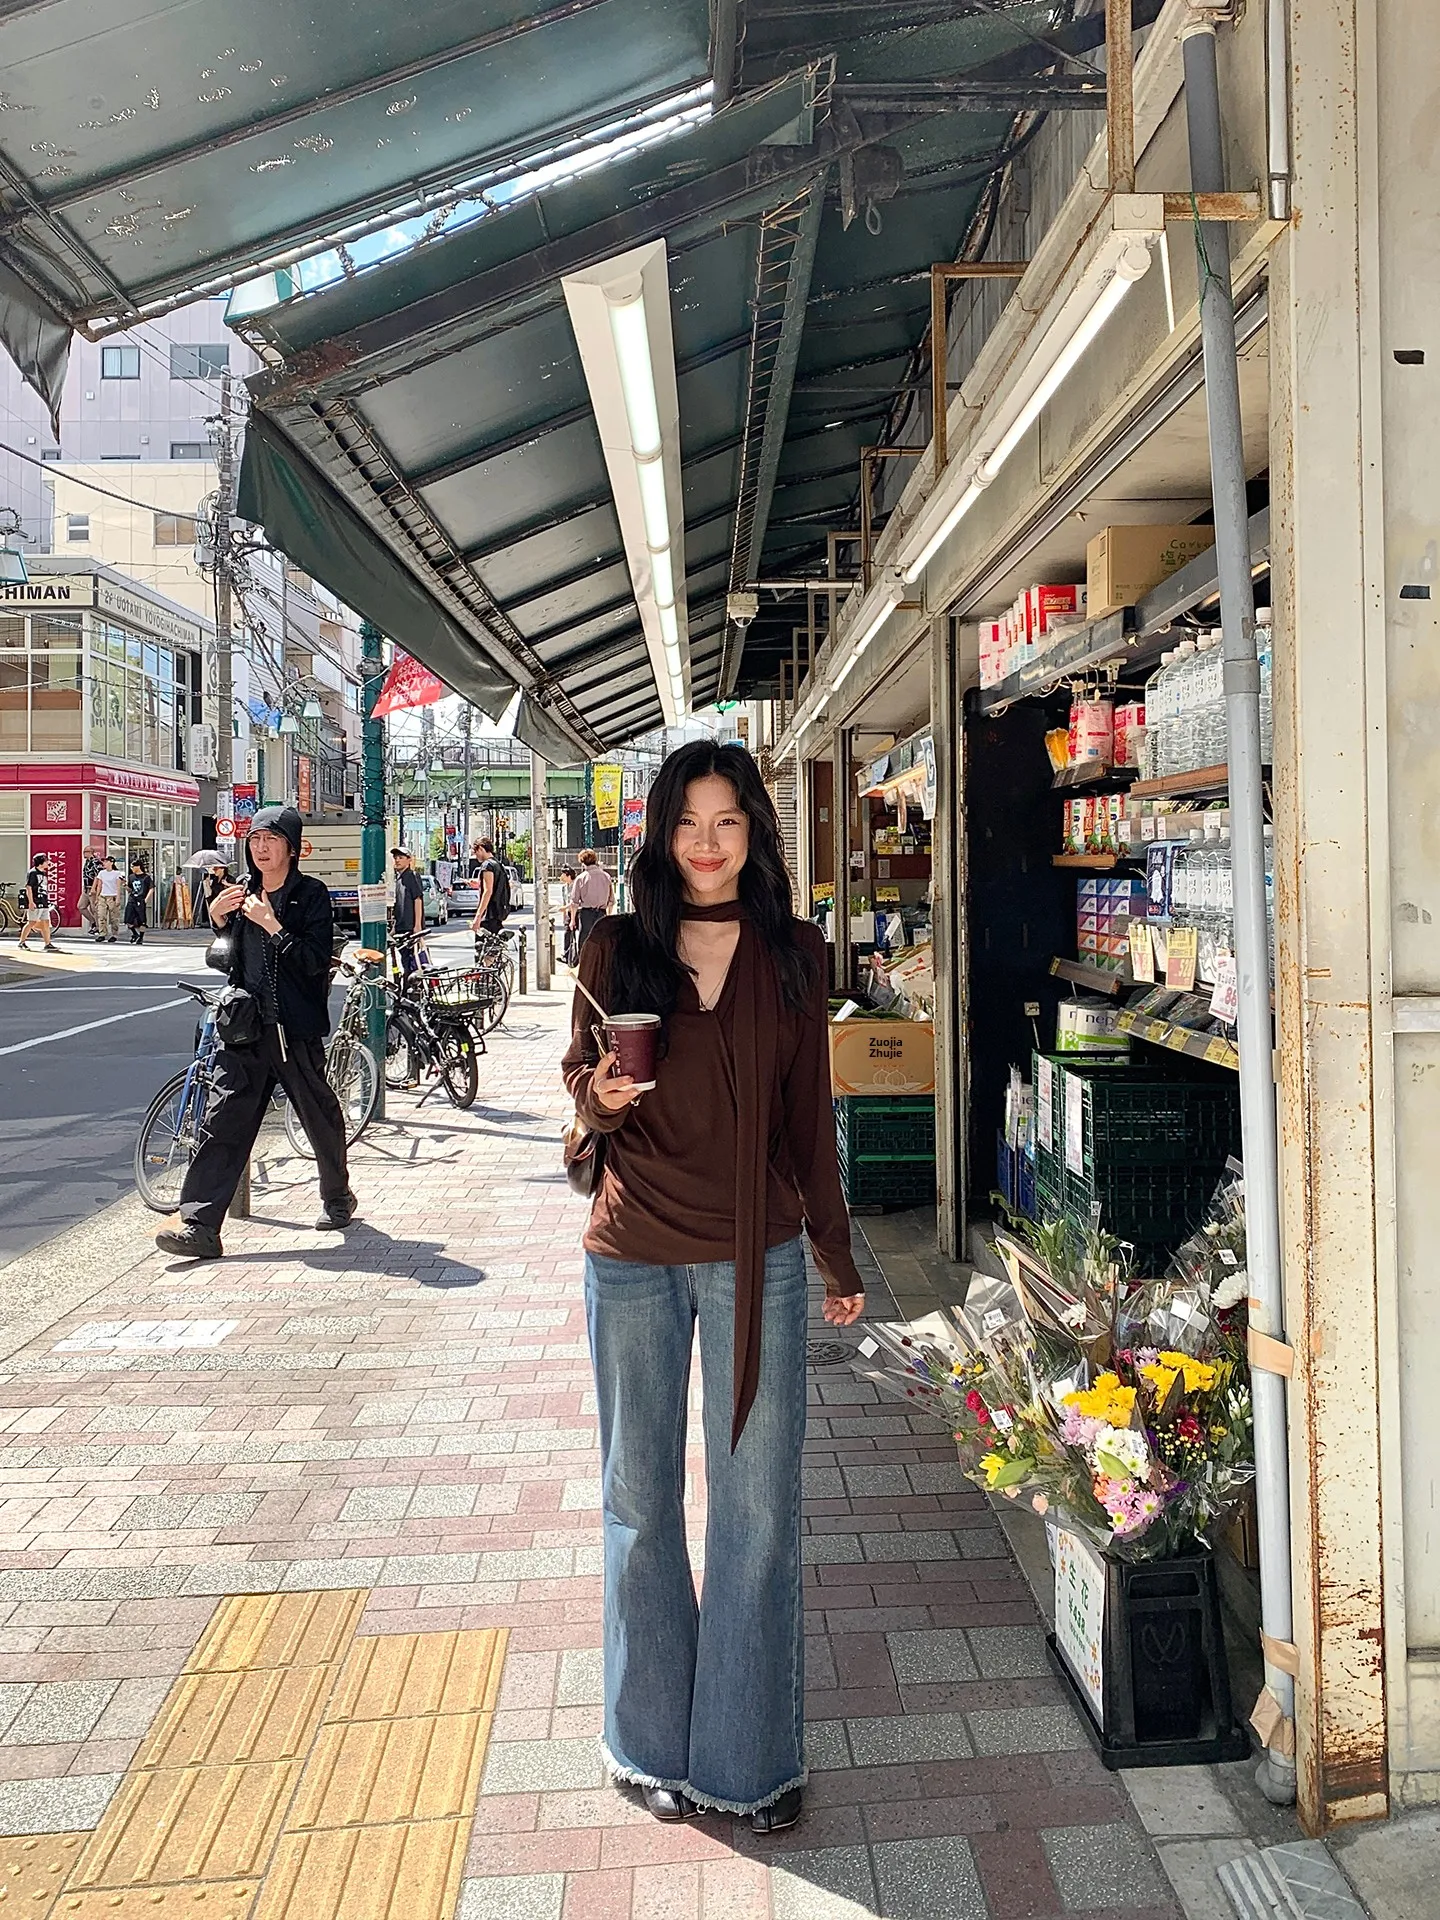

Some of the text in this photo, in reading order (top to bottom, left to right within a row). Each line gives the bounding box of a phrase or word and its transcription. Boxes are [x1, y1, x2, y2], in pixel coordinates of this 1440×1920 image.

[0, 585, 70, 600] HIMAN
[869, 1037, 903, 1050] Zuojia
[869, 1048, 903, 1060] Zhujie
